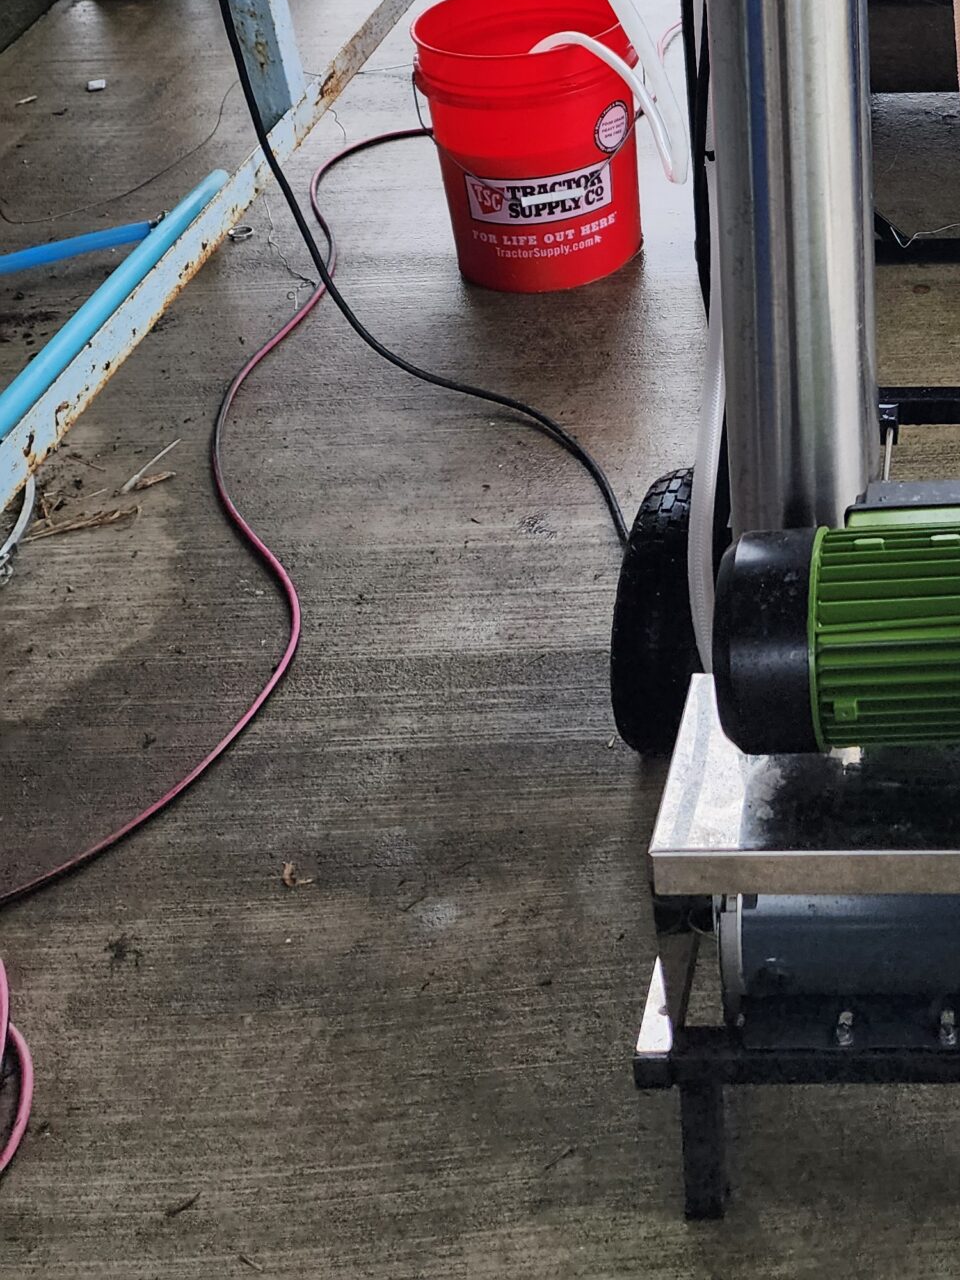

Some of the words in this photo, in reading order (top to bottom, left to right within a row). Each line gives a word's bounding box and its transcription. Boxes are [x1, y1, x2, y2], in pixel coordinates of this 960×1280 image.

[474, 184, 502, 211] TSC
[506, 169, 602, 202] TRACTOR
[508, 194, 582, 218] SUPPLY
[472, 230, 498, 245] FOR
[503, 234, 537, 245] LIFE
[543, 230, 575, 244] OUT
[580, 213, 616, 236] HERE
[495, 237, 594, 258] TractorSupply.com
